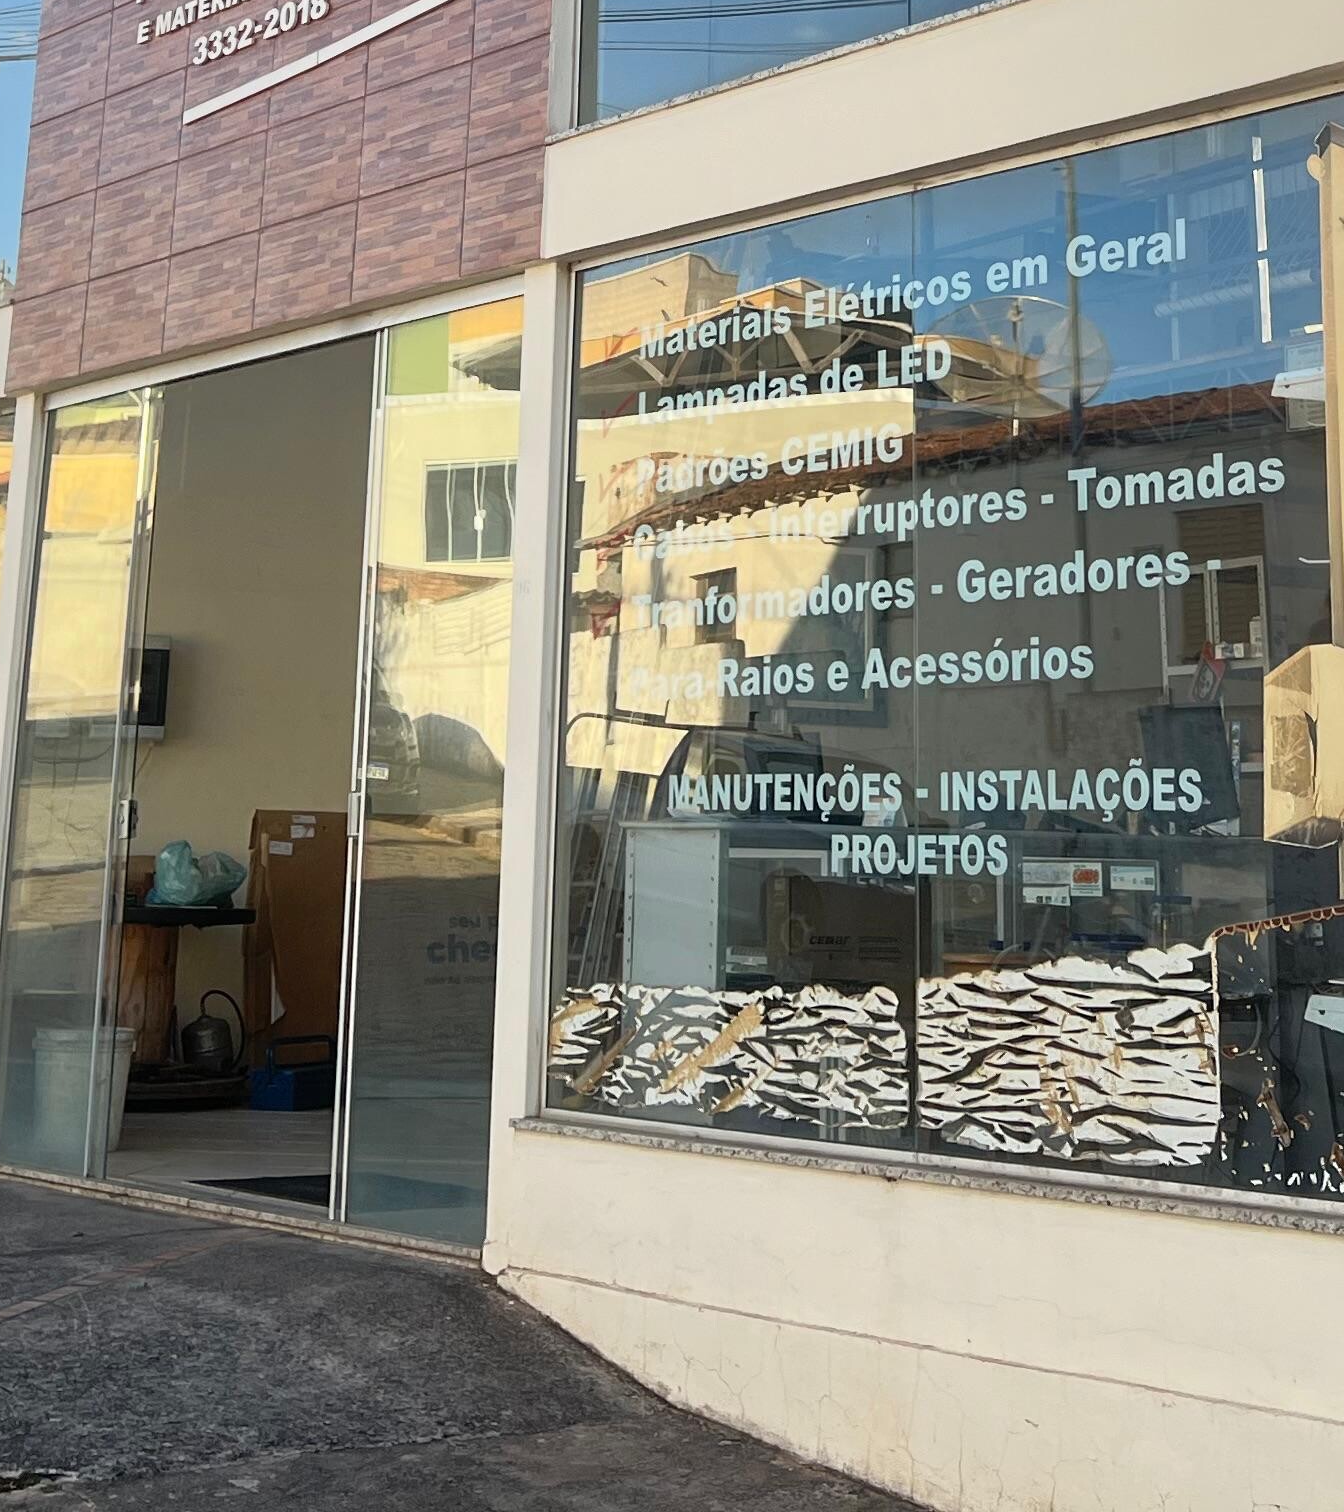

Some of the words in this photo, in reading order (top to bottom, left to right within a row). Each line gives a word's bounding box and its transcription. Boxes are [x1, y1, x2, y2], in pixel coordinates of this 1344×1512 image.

[136, 20, 151, 45] E
[639, 304, 792, 361] Materiais
[804, 266, 973, 330] Elétricos
[985, 254, 1048, 291] em
[1066, 218, 1187, 278] Geral
[820, 357, 864, 394] de
[877, 339, 952, 390] LED
[780, 422, 904, 477] CEMIG
[769, 486, 1028, 544] Interruptores
[1041, 493, 1054, 505] -
[1067, 452, 1286, 512] Tomadas
[631, 574, 916, 628] Tranformadores
[930, 583, 944, 595] -
[957, 549, 1192, 603] Geradores
[827, 660, 850, 692] e
[861, 636, 1095, 690] Acessórios
[668, 763, 903, 823] MANUTENÇÕES
[916, 787, 929, 799] -
[940, 757, 1204, 823] INSTALAÇÕES
[830, 834, 1008, 877] PROJETOS
